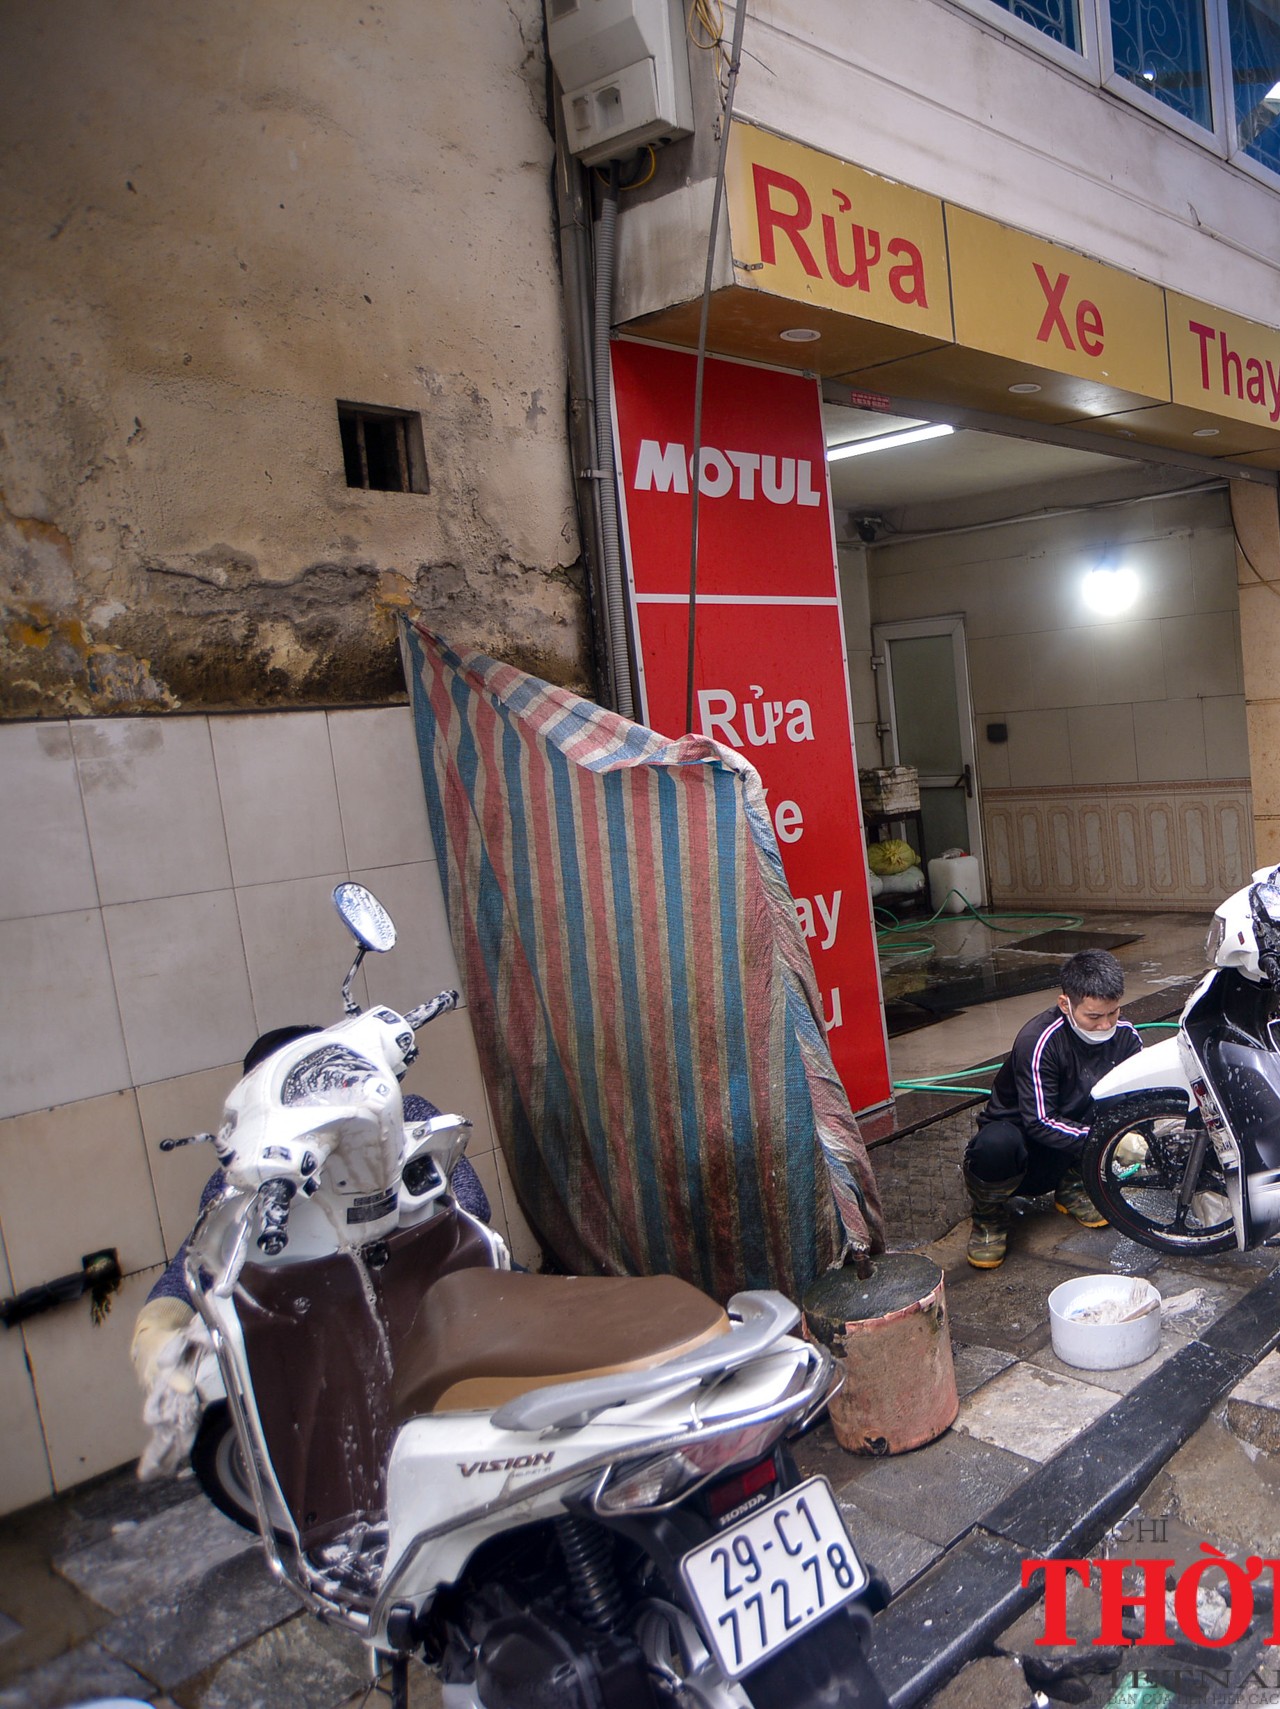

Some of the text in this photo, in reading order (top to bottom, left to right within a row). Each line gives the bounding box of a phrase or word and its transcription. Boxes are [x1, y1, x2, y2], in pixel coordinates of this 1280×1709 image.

[751, 163, 929, 309] Rửa
[1032, 262, 1106, 358] Xe
[634, 439, 822, 507] MOTUL
[697, 684, 815, 748] Rửa
[795, 891, 843, 950] ay
[457, 1451, 555, 1478] VISION
[718, 1492, 768, 1526] HONDA
[710, 1497, 822, 1600] 29-C1
[718, 1542, 856, 1666] 772.78
